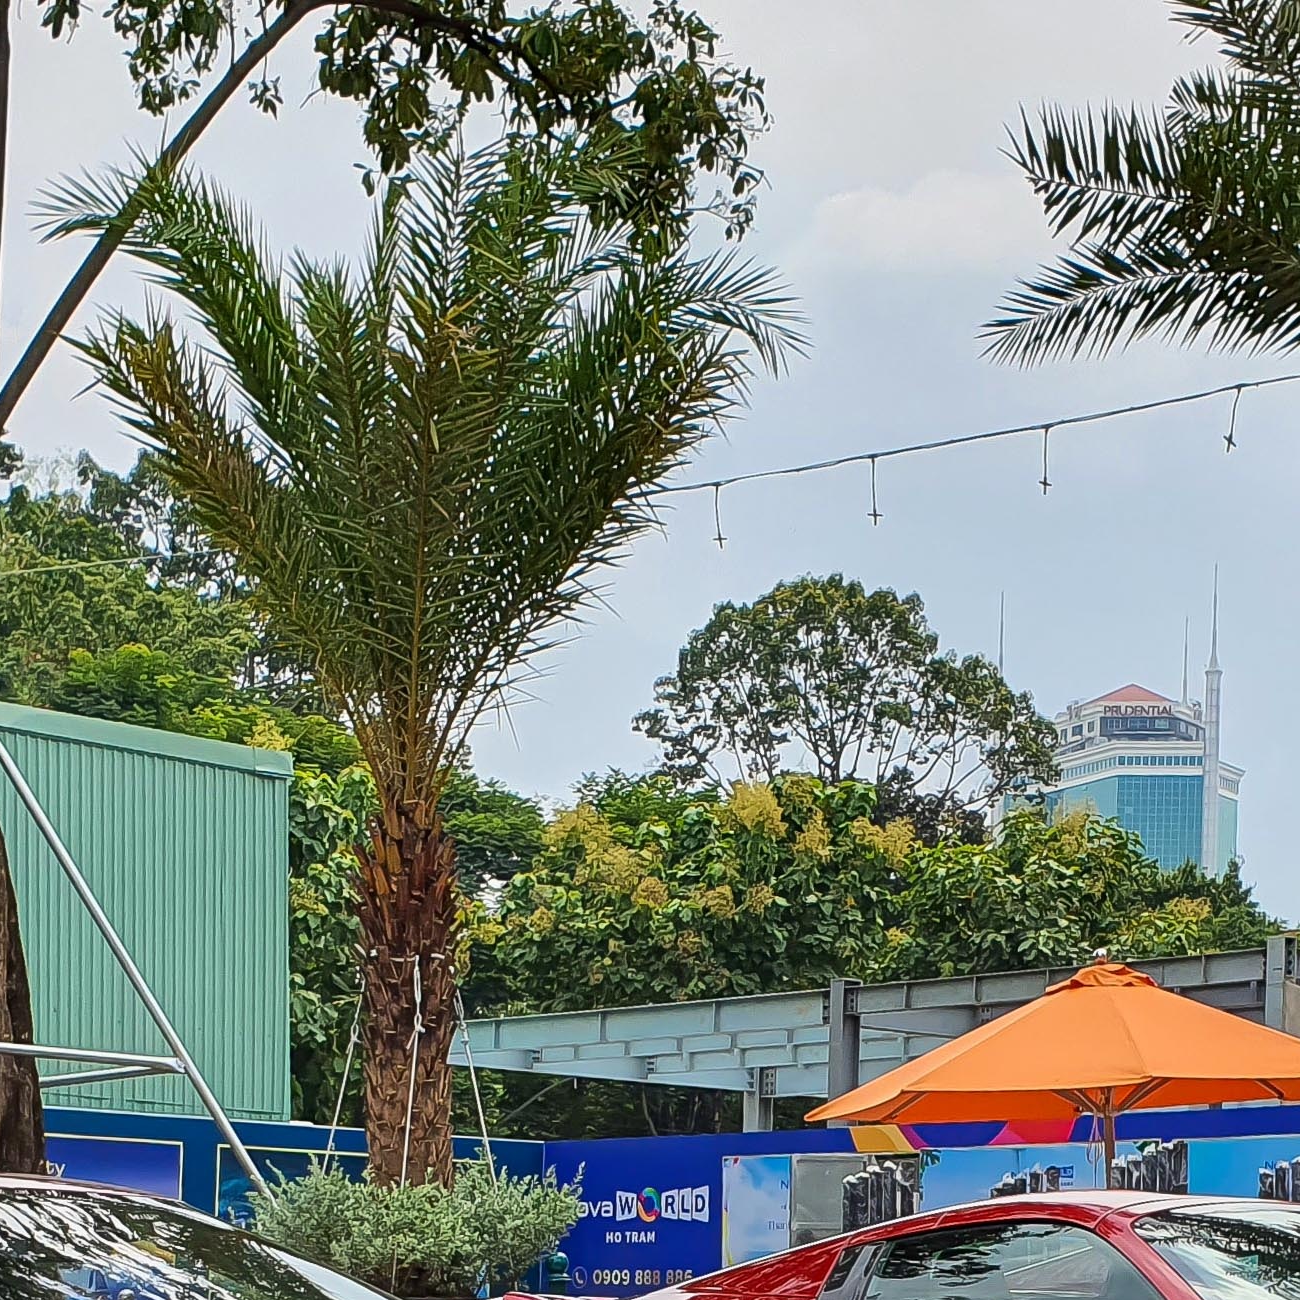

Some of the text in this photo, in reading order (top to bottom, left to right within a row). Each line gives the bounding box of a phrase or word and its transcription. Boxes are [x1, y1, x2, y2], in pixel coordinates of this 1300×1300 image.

[1103, 704, 1173, 717] PRUDENTIAL
[605, 1231, 656, 1243] HO TRAM
[592, 1269, 630, 1285] 0909
[635, 1269, 660, 1285] 888
